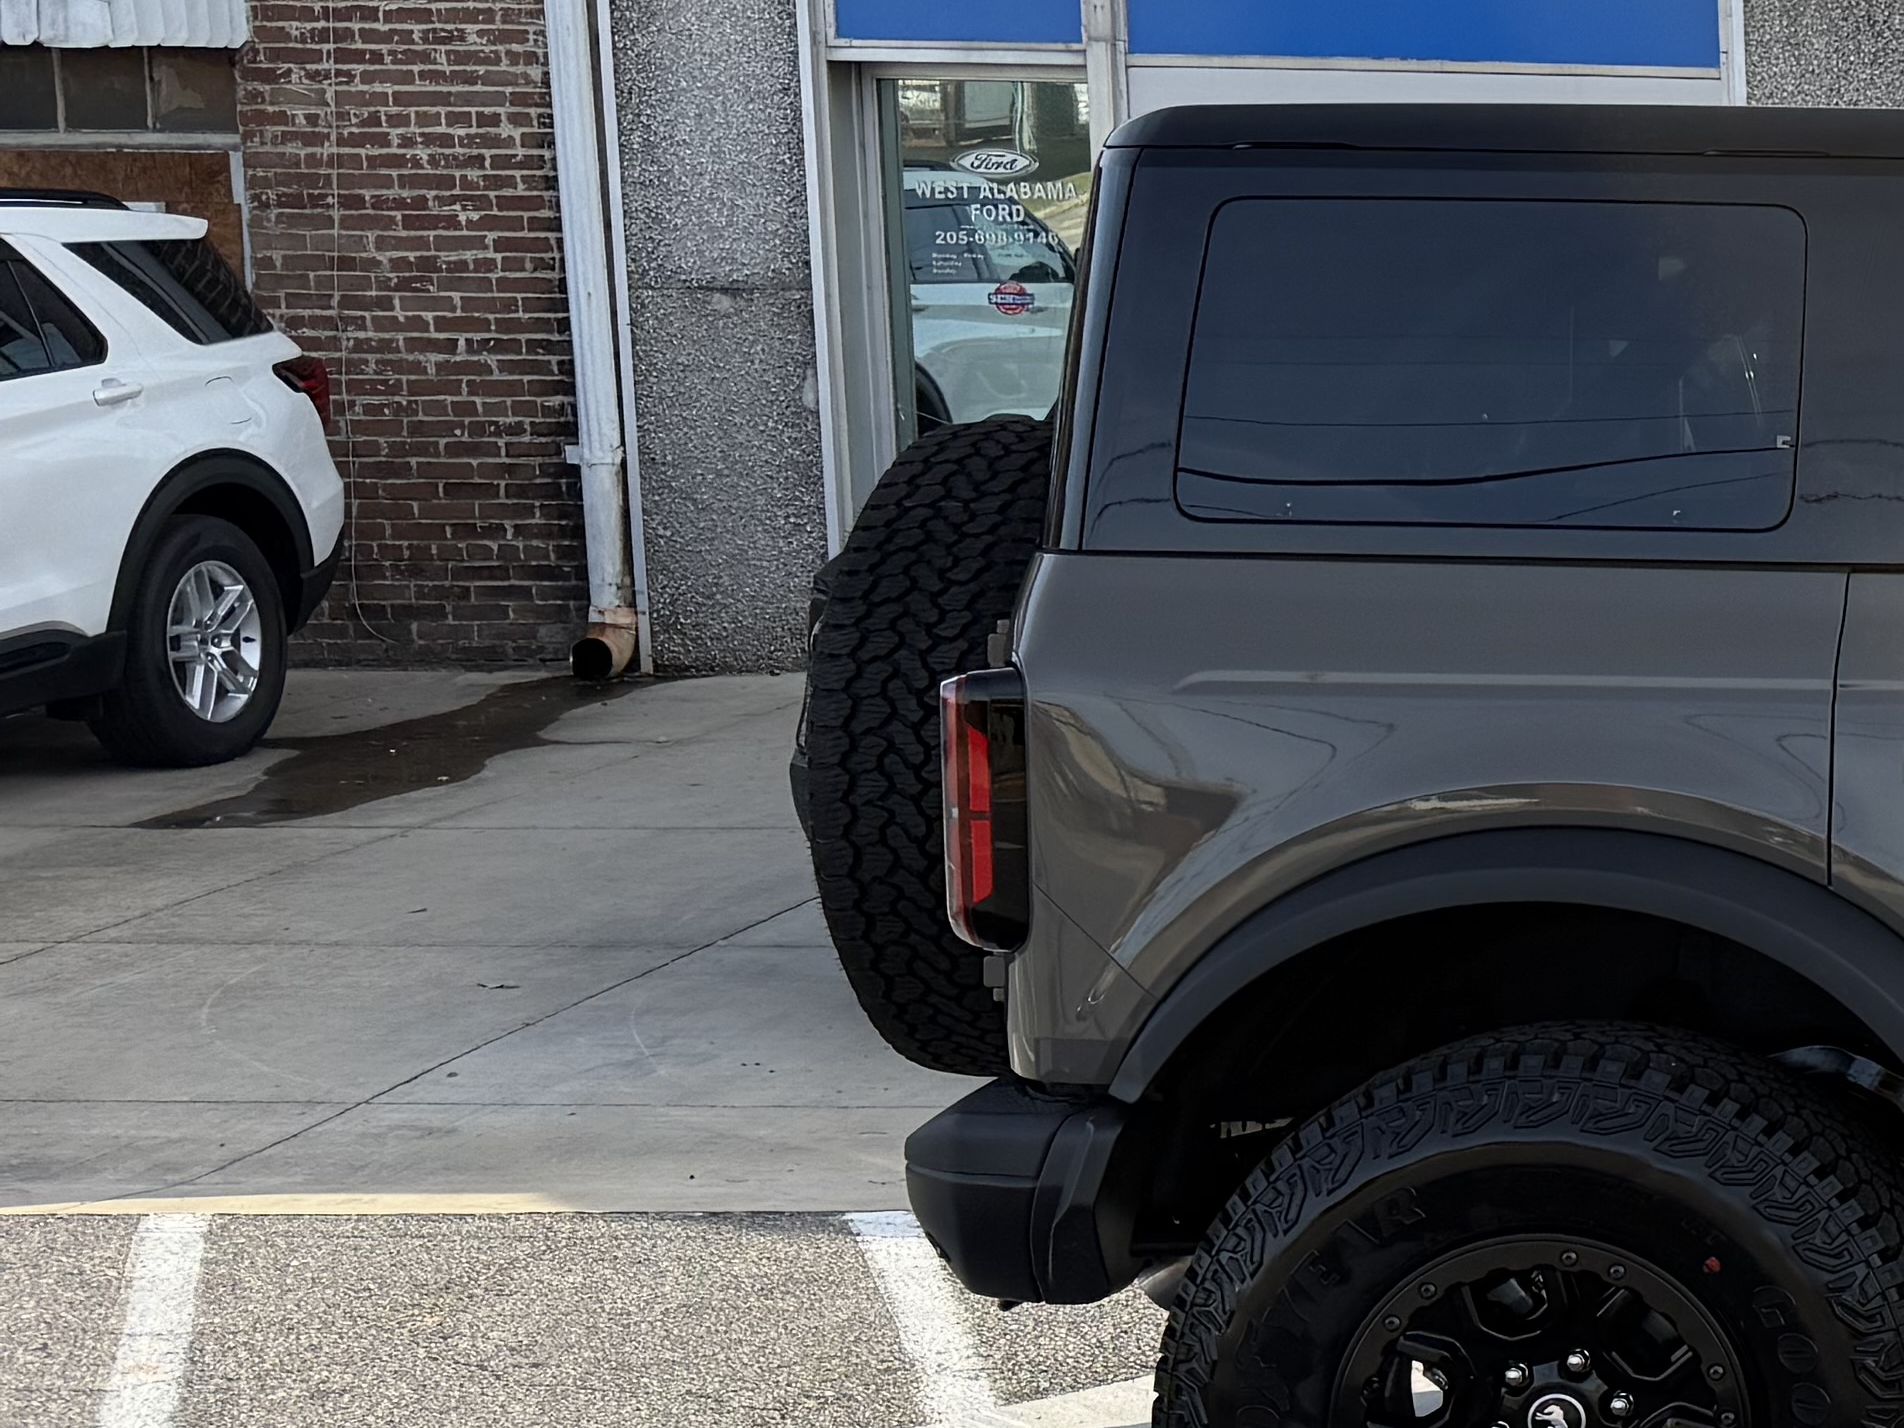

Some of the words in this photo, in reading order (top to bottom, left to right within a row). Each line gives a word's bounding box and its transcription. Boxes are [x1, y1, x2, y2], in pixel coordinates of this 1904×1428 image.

[969, 153, 1019, 172] Ford
[914, 180, 970, 200] WEST
[978, 180, 1078, 201] ALABAMA
[970, 203, 1026, 223] FORD
